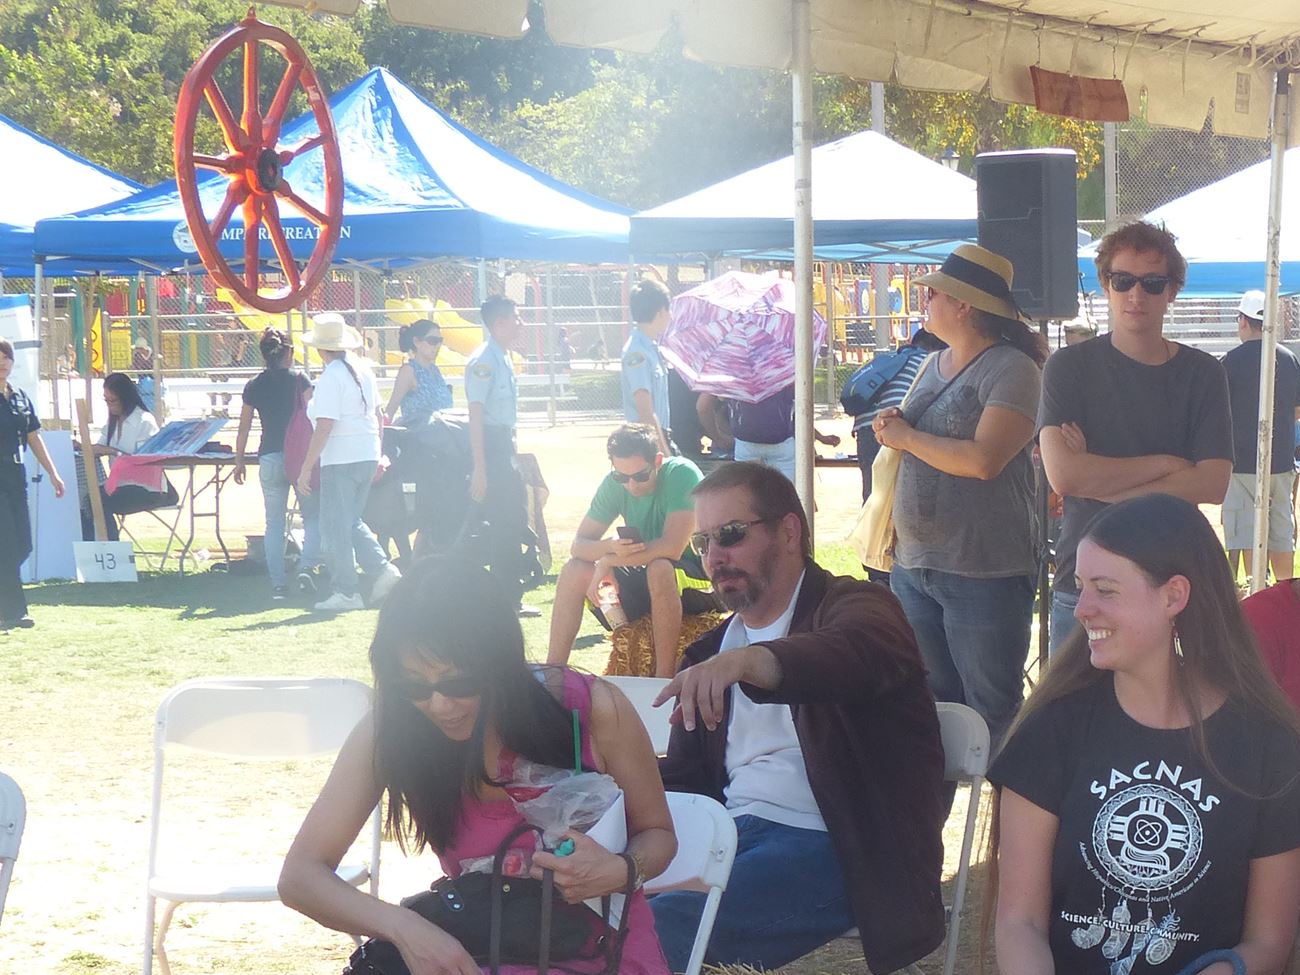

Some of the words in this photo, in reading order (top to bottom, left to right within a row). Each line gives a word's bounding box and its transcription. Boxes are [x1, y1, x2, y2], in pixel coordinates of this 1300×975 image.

[259, 226, 351, 240] RREATN
[95, 553, 116, 570] 43
[1090, 760, 1220, 812] SACNAS
